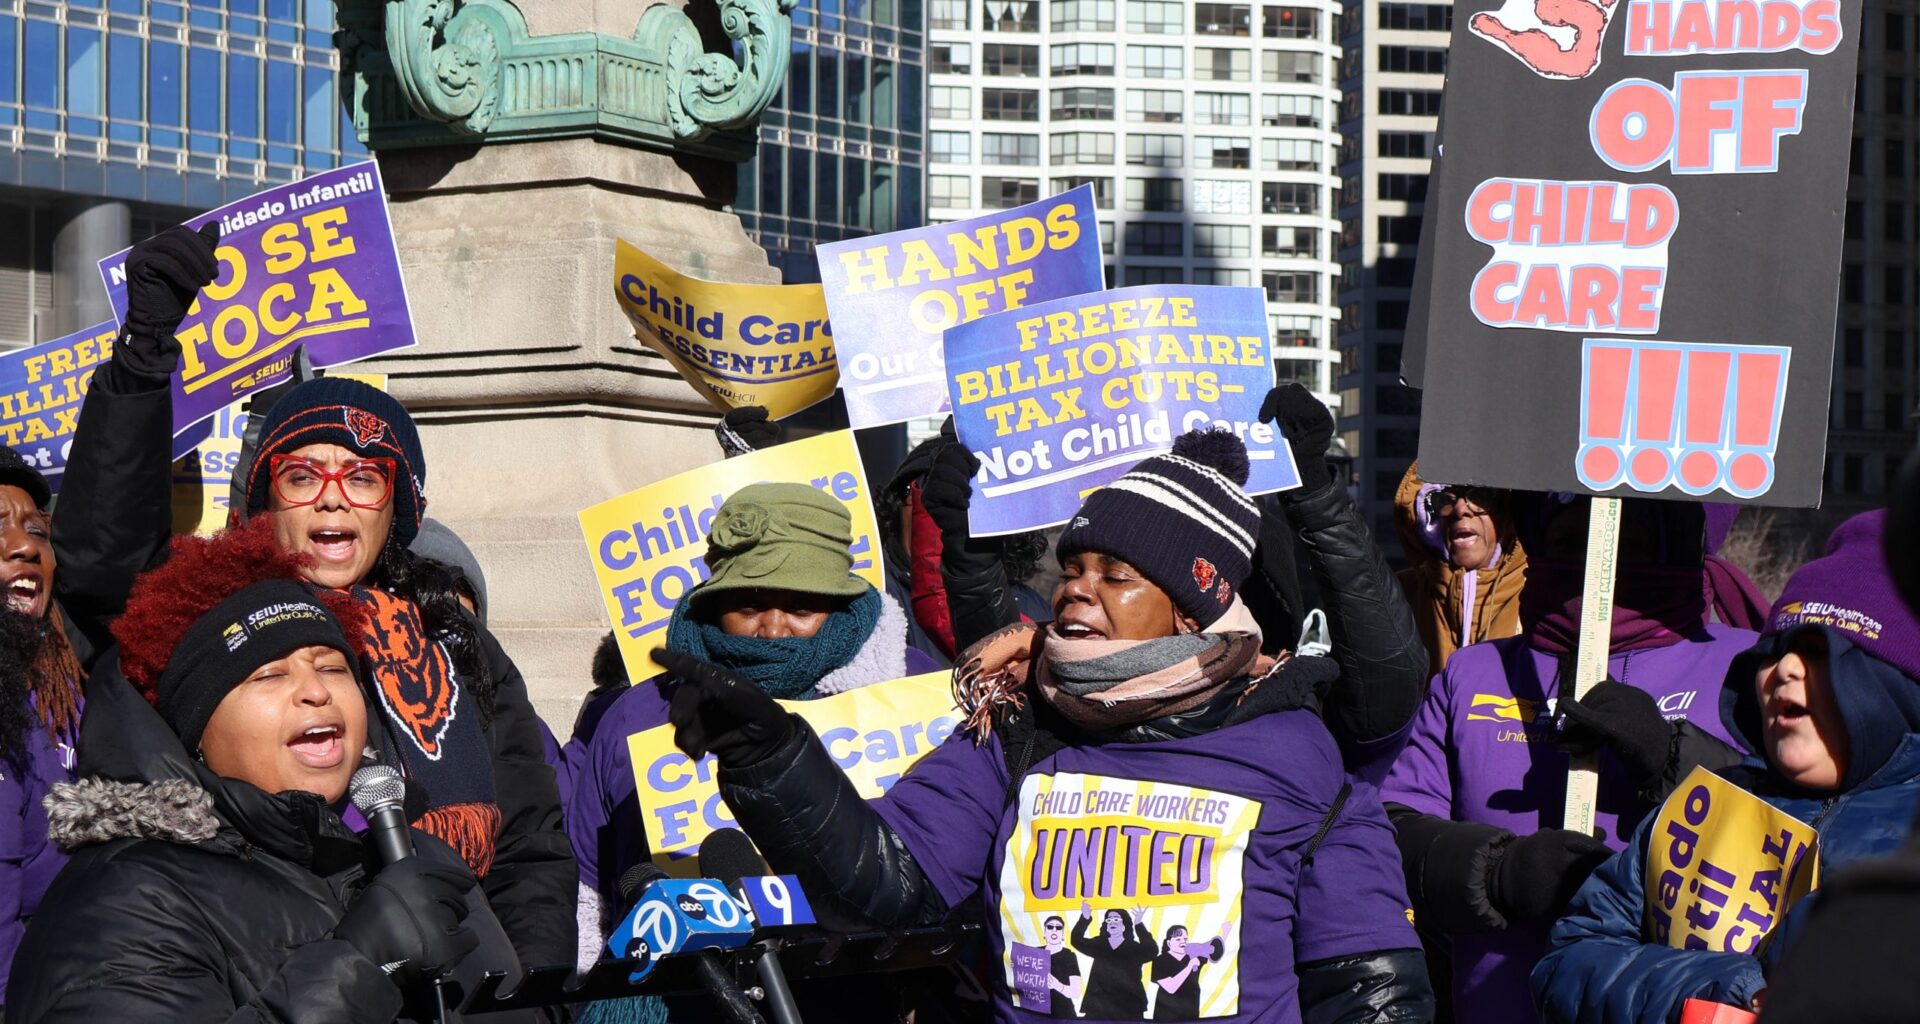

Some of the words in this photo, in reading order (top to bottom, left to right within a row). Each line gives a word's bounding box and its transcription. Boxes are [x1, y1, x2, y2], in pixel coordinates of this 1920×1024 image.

[1591, 70, 1808, 172] OFF
[219, 201, 285, 236] uidado
[290, 172, 374, 211] Infantil
[1467, 179, 1679, 248] CHILD
[190, 245, 248, 315] O
[261, 206, 356, 275] SE
[839, 204, 1080, 295] HANDS
[176, 268, 367, 381] TOCA
[620, 274, 724, 340] Child
[909, 268, 1033, 334] OFF
[1016, 297, 1197, 352] FREEZE
[1471, 261, 1666, 331] CARE
[24, 330, 117, 384] FREE
[256, 354, 294, 380] SEIUH
[658, 326, 837, 375] ESSENTIAL
[850, 349, 916, 380] Our
[955, 334, 1265, 405] BILLIONAIRE
[0, 407, 79, 446] TAX
[985, 387, 1086, 437] TAX
[976, 440, 1052, 484] Not
[1061, 410, 1172, 461] Child
[612, 559, 711, 627] FO
[1598, 597, 1610, 622] VISIT
[1033, 792, 1082, 816] CHILD
[1085, 790, 1133, 814] CARE
[1136, 794, 1230, 824] WORKERS
[1031, 825, 1215, 899] UNITED
[1652, 784, 1711, 947] dado
[1724, 829, 1793, 955] CIAL
[679, 900, 704, 912] abc
[761, 876, 793, 925] 9
[1016, 954, 1044, 971] WE'RE
[1016, 971, 1046, 988] WORTH
